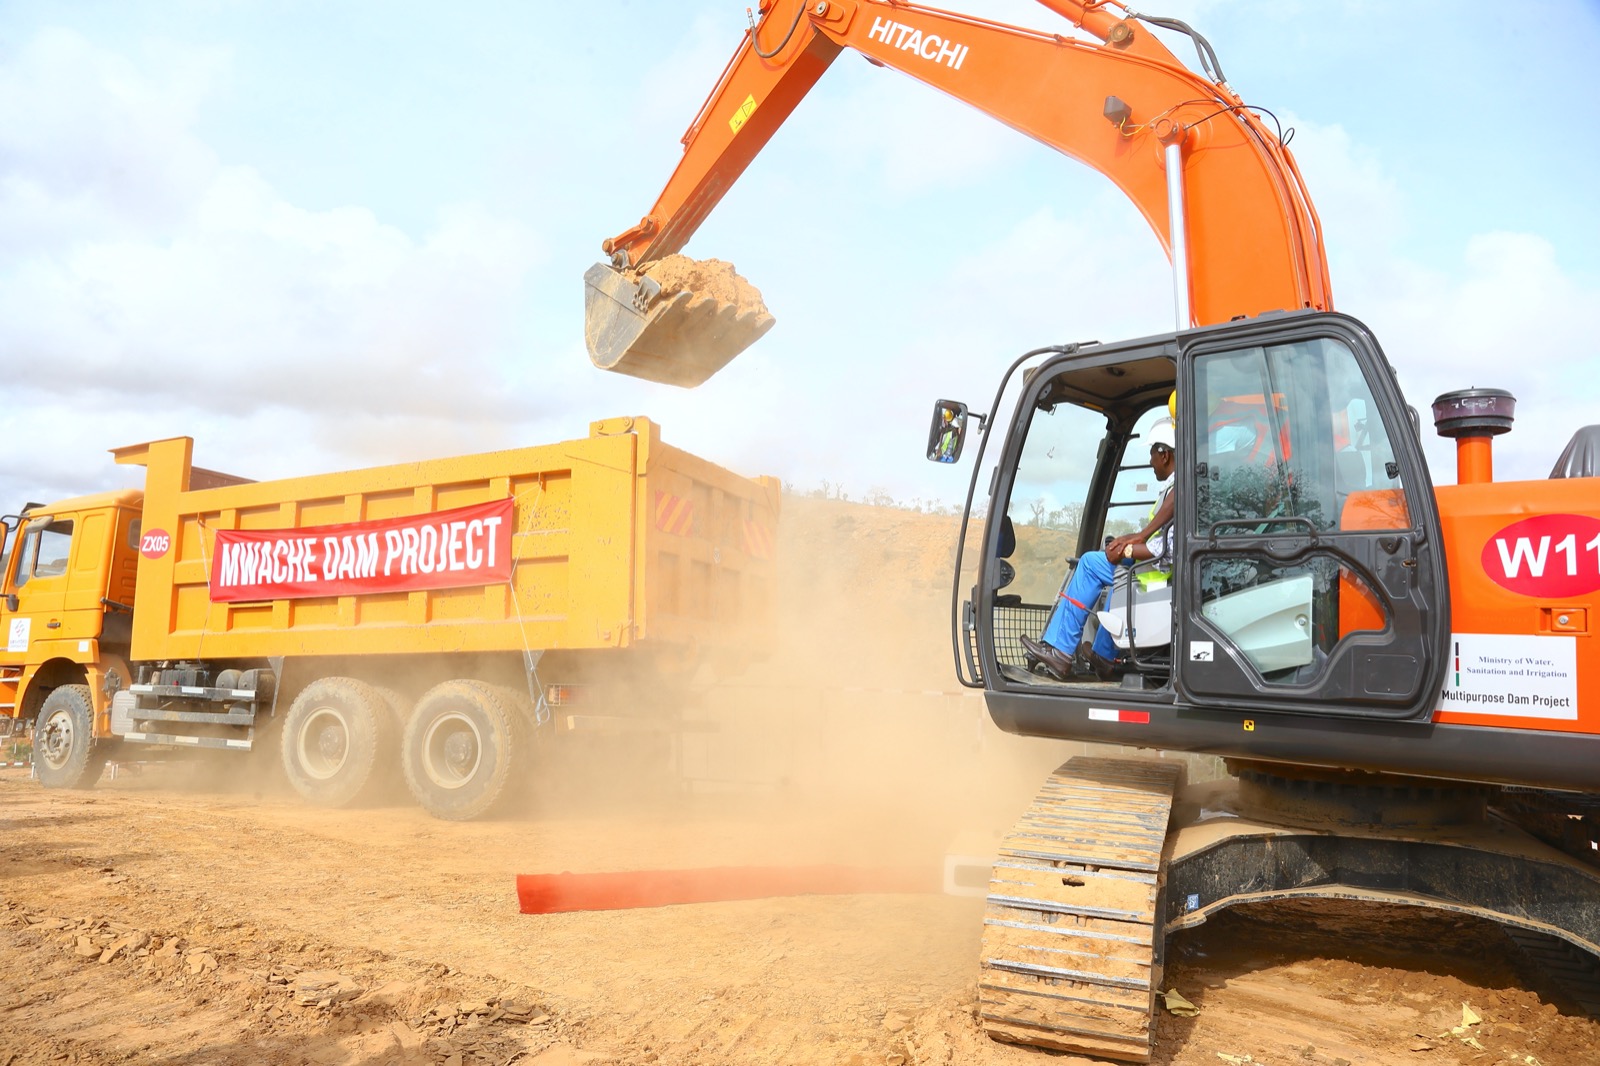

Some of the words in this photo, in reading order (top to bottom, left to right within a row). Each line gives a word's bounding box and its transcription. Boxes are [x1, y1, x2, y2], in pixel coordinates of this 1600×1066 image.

[868, 16, 969, 70] HITACHI
[142, 536, 169, 552] ZX05
[220, 538, 317, 587] MWACHE
[322, 532, 378, 581] DAM
[384, 516, 502, 576] PROJECT
[1479, 656, 1512, 665] Ministry
[1515, 657, 1523, 665] of
[1526, 658, 1554, 666] Water,
[1466, 667, 1506, 675] Sanitation
[1527, 669, 1567, 678] Irrigation
[1442, 690, 1504, 704] Multipurpose
[1507, 693, 1530, 705] Dam
[1532, 695, 1570, 708] Project
